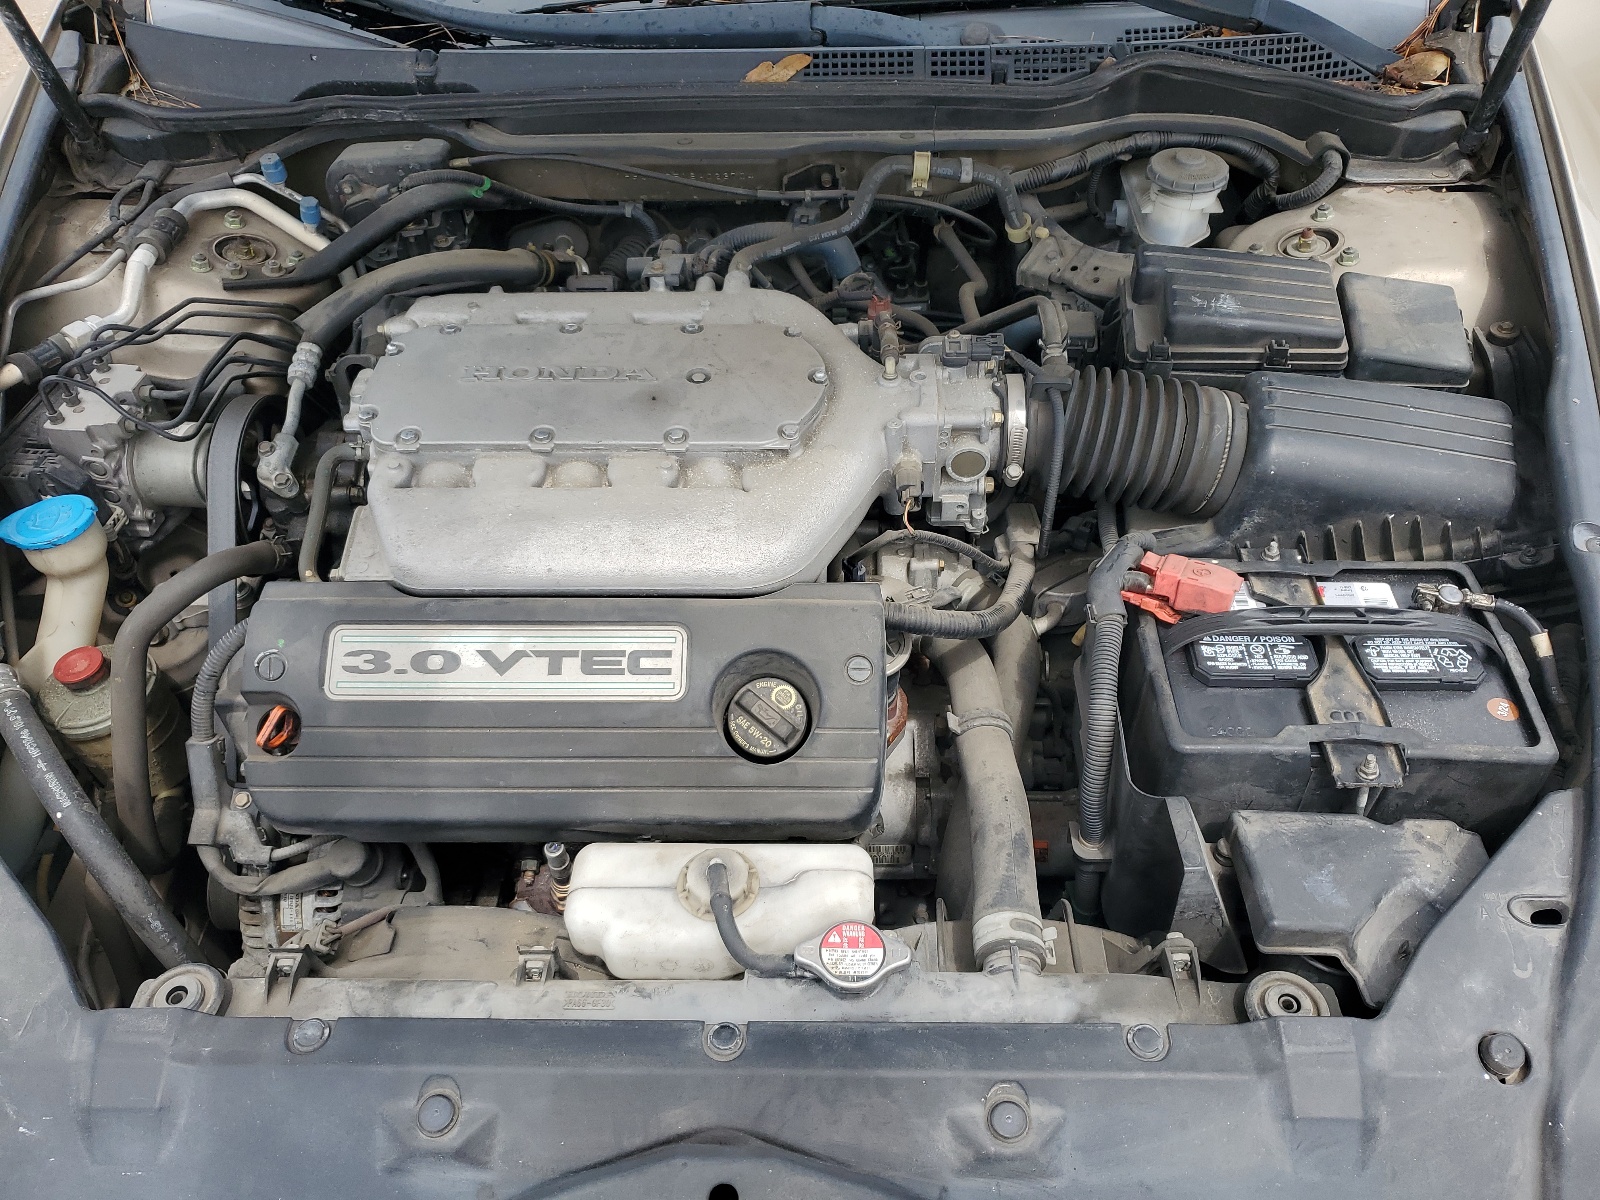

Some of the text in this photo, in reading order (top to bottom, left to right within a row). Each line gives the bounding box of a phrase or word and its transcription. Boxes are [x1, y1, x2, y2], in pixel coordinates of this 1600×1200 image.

[459, 366, 658, 382] HONDA
[1260, 635, 1295, 643] POISON
[341, 649, 674, 677] 3.0 VTEC
[756, 681, 777, 689] ENGINE
[736, 715, 751, 729] SAE
[748, 726, 772, 748] 5W-20
